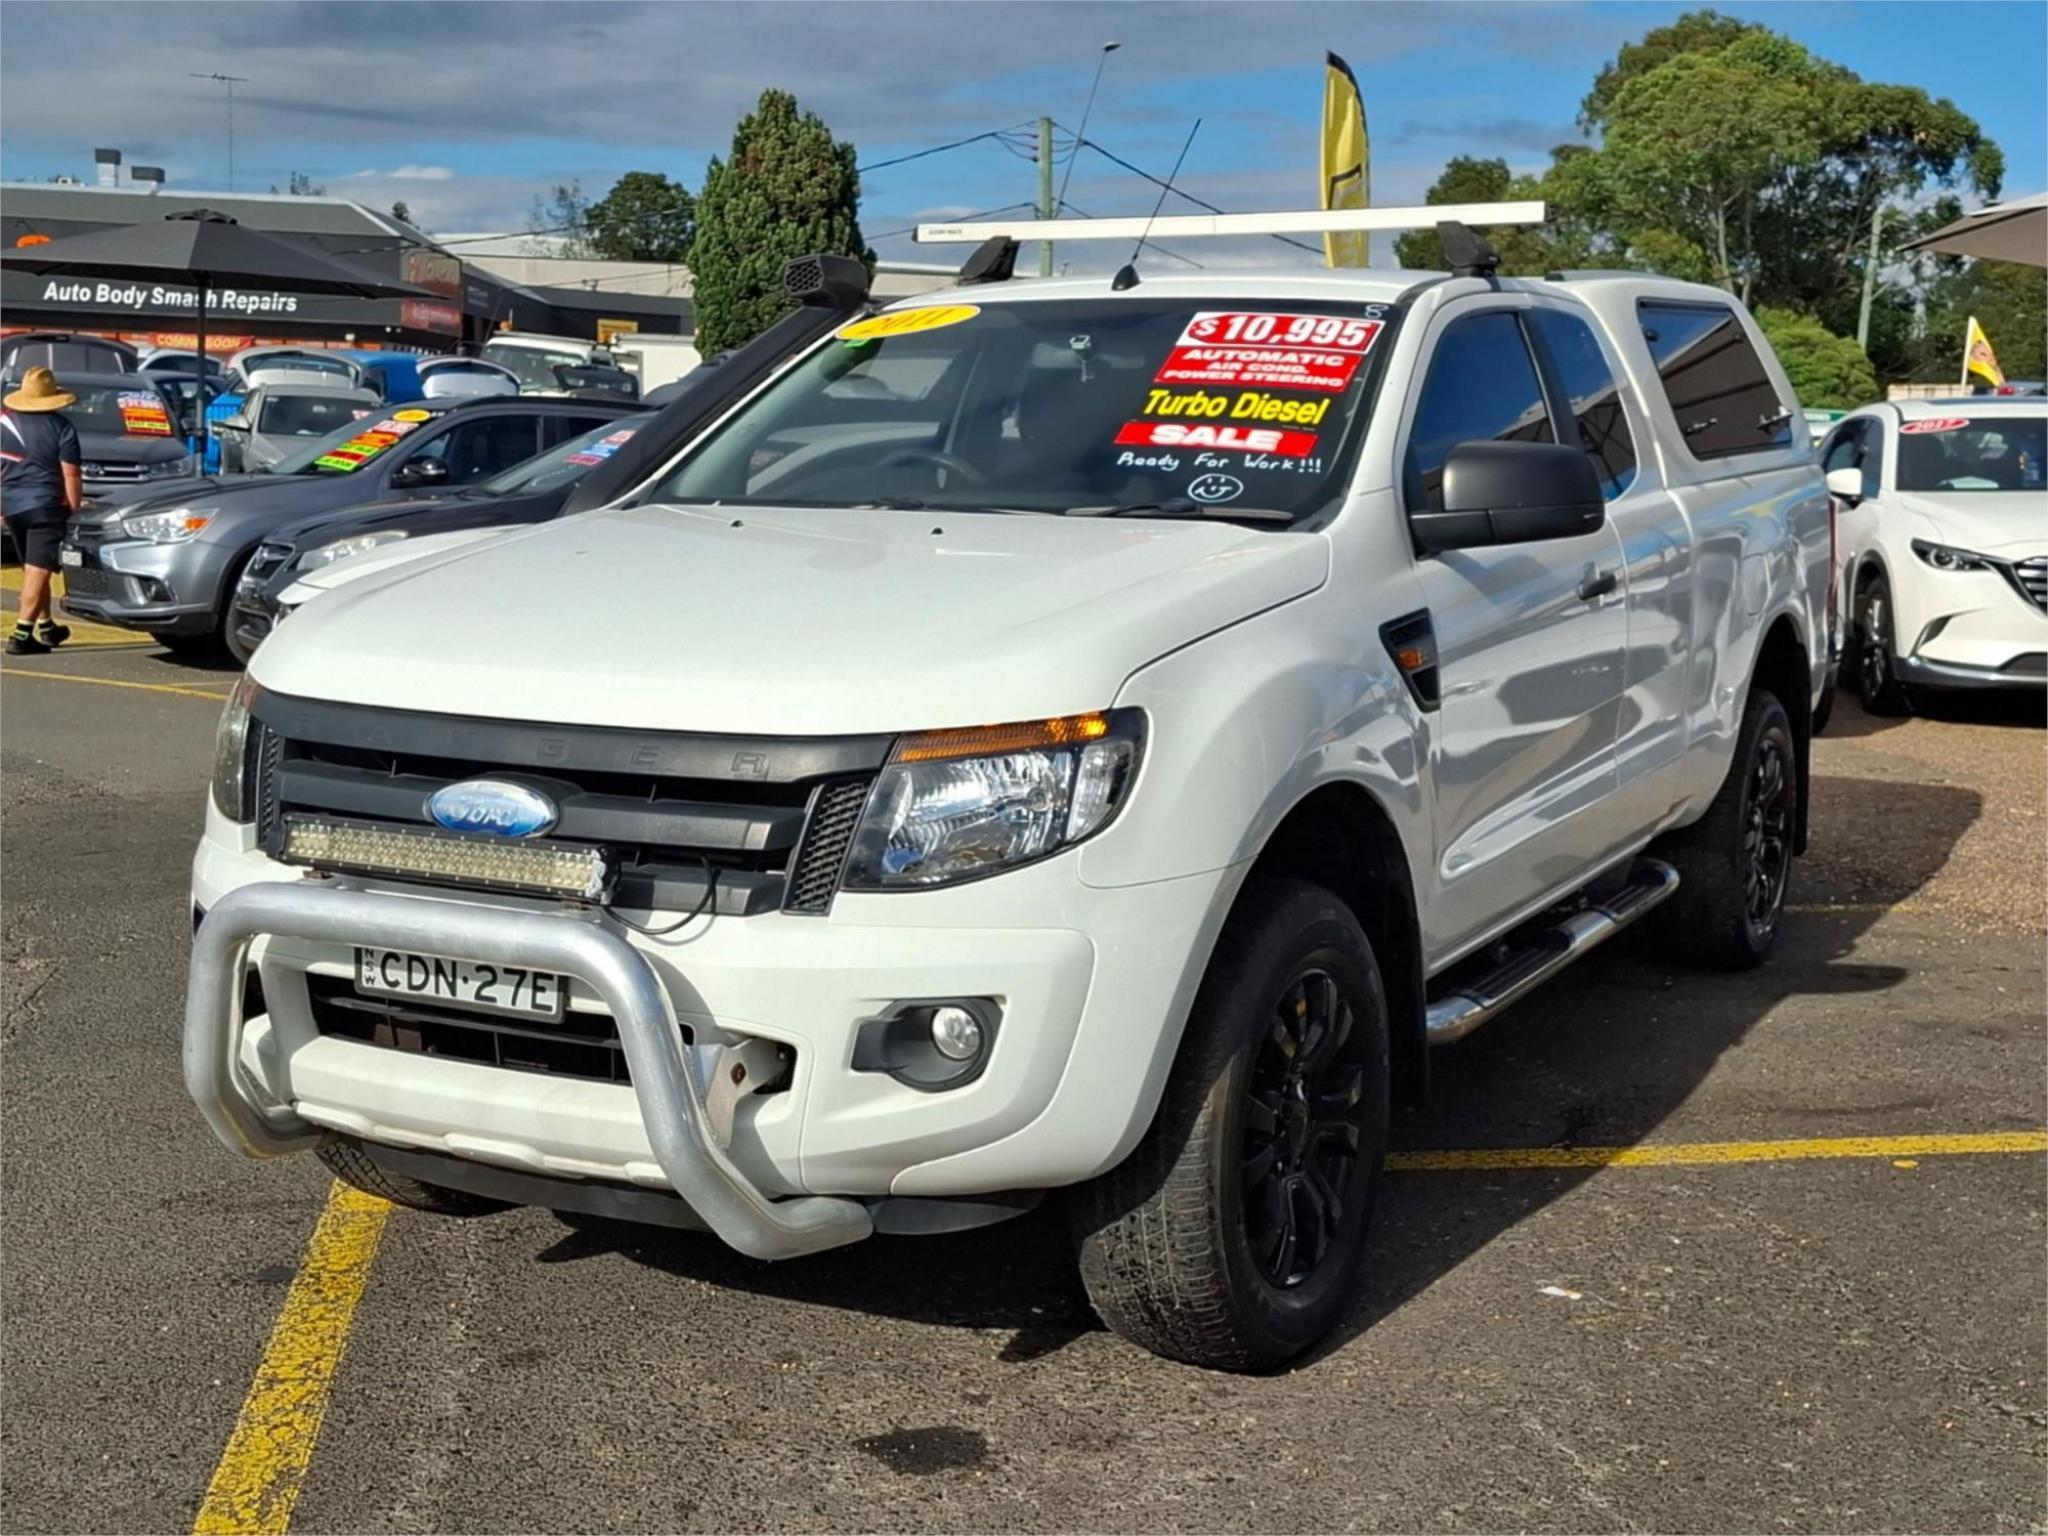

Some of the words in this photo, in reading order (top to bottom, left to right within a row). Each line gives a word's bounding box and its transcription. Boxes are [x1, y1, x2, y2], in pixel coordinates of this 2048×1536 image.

[44, 282, 91, 301] Auto
[95, 284, 147, 309] Body
[221, 290, 297, 314] Repairs
[157, 333, 199, 347] COMIN
[1195, 315, 1372, 347] $10,995
[1182, 349, 1345, 366] AUTOMATIC
[1206, 362, 1243, 371] AIR
[1247, 363, 1309, 374] COND.
[1163, 370, 1235, 380] POWER
[1240, 372, 1343, 387] STEERING
[1144, 389, 1228, 417] Turbo
[1230, 392, 1330, 425] Diesel
[1150, 424, 1283, 451] SALE
[1116, 452, 1180, 472] Ready
[1194, 453, 1230, 468] For
